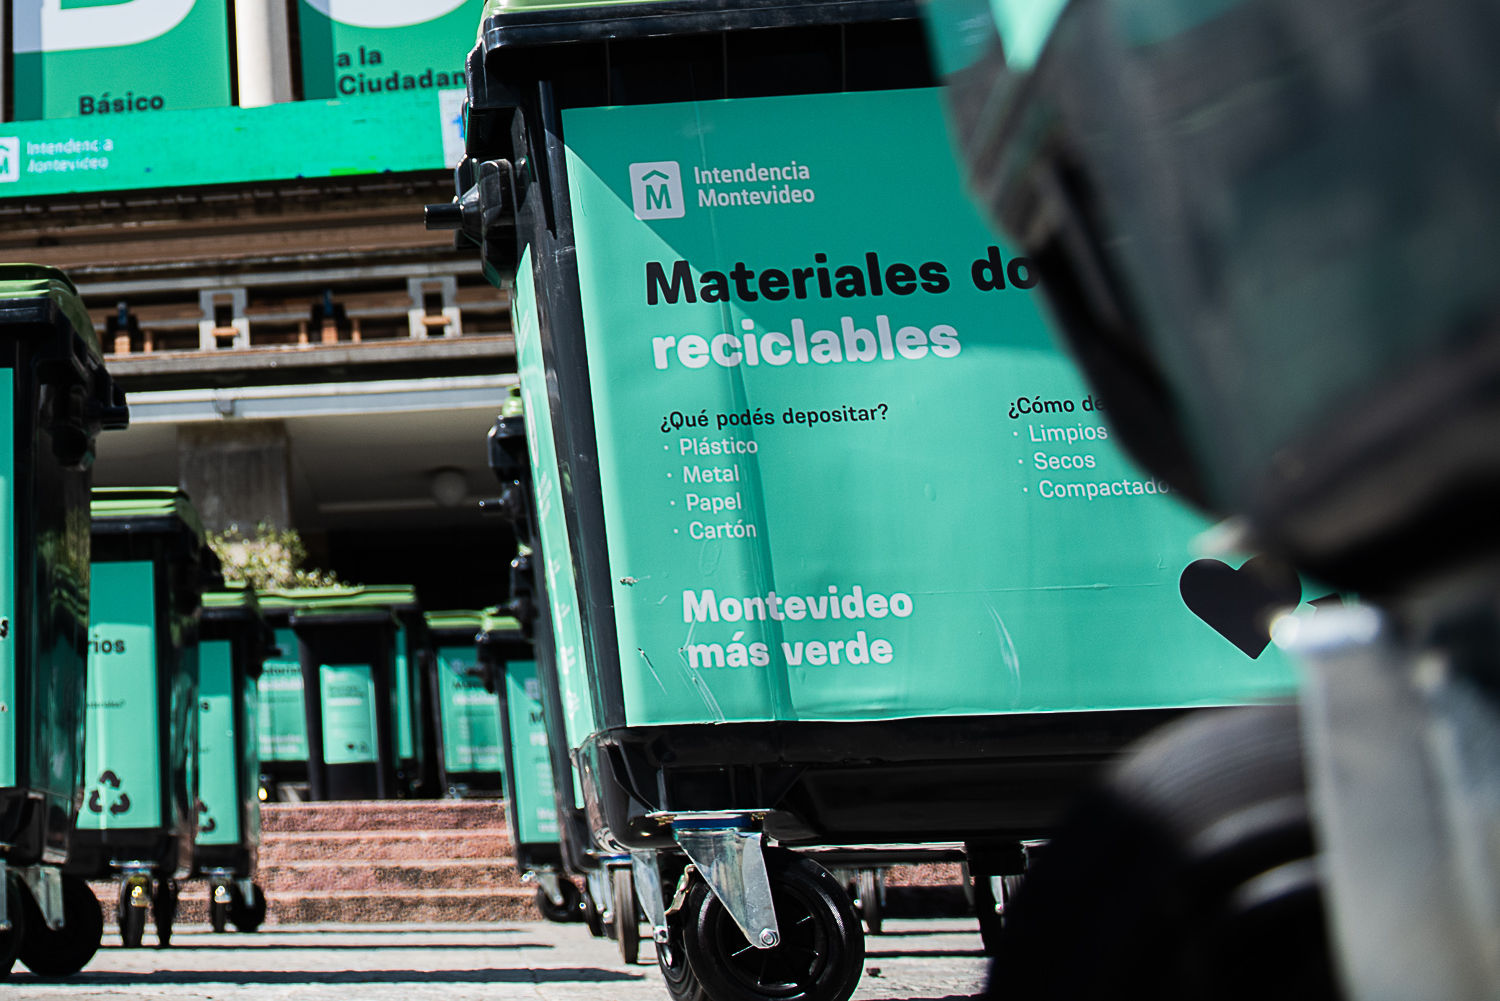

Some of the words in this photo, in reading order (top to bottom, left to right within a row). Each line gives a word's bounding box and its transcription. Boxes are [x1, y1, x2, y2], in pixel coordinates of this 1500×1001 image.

[337, 53, 350, 67] a
[359, 47, 382, 65] la
[79, 91, 164, 116] Básico
[27, 138, 113, 155] Intendenca
[694, 160, 810, 185] Intendencia
[698, 184, 816, 208] Montevideo
[645, 251, 951, 305] Materiales
[652, 314, 962, 370] reciclables
[660, 409, 709, 433] ¿Qué
[716, 407, 775, 430] podés
[782, 403, 889, 427] depositar?
[1008, 396, 1075, 419] ¿Cómo
[1028, 423, 1108, 445] Limpios
[679, 436, 759, 456] Plástico
[1033, 451, 1096, 470] Secos
[683, 464, 740, 484] Metal
[1039, 477, 1175, 501] Compactado
[686, 492, 742, 514] Papel
[689, 519, 757, 540] Cartón
[683, 585, 914, 623] Montevideo
[688, 631, 770, 668] más
[781, 631, 893, 667] verde
